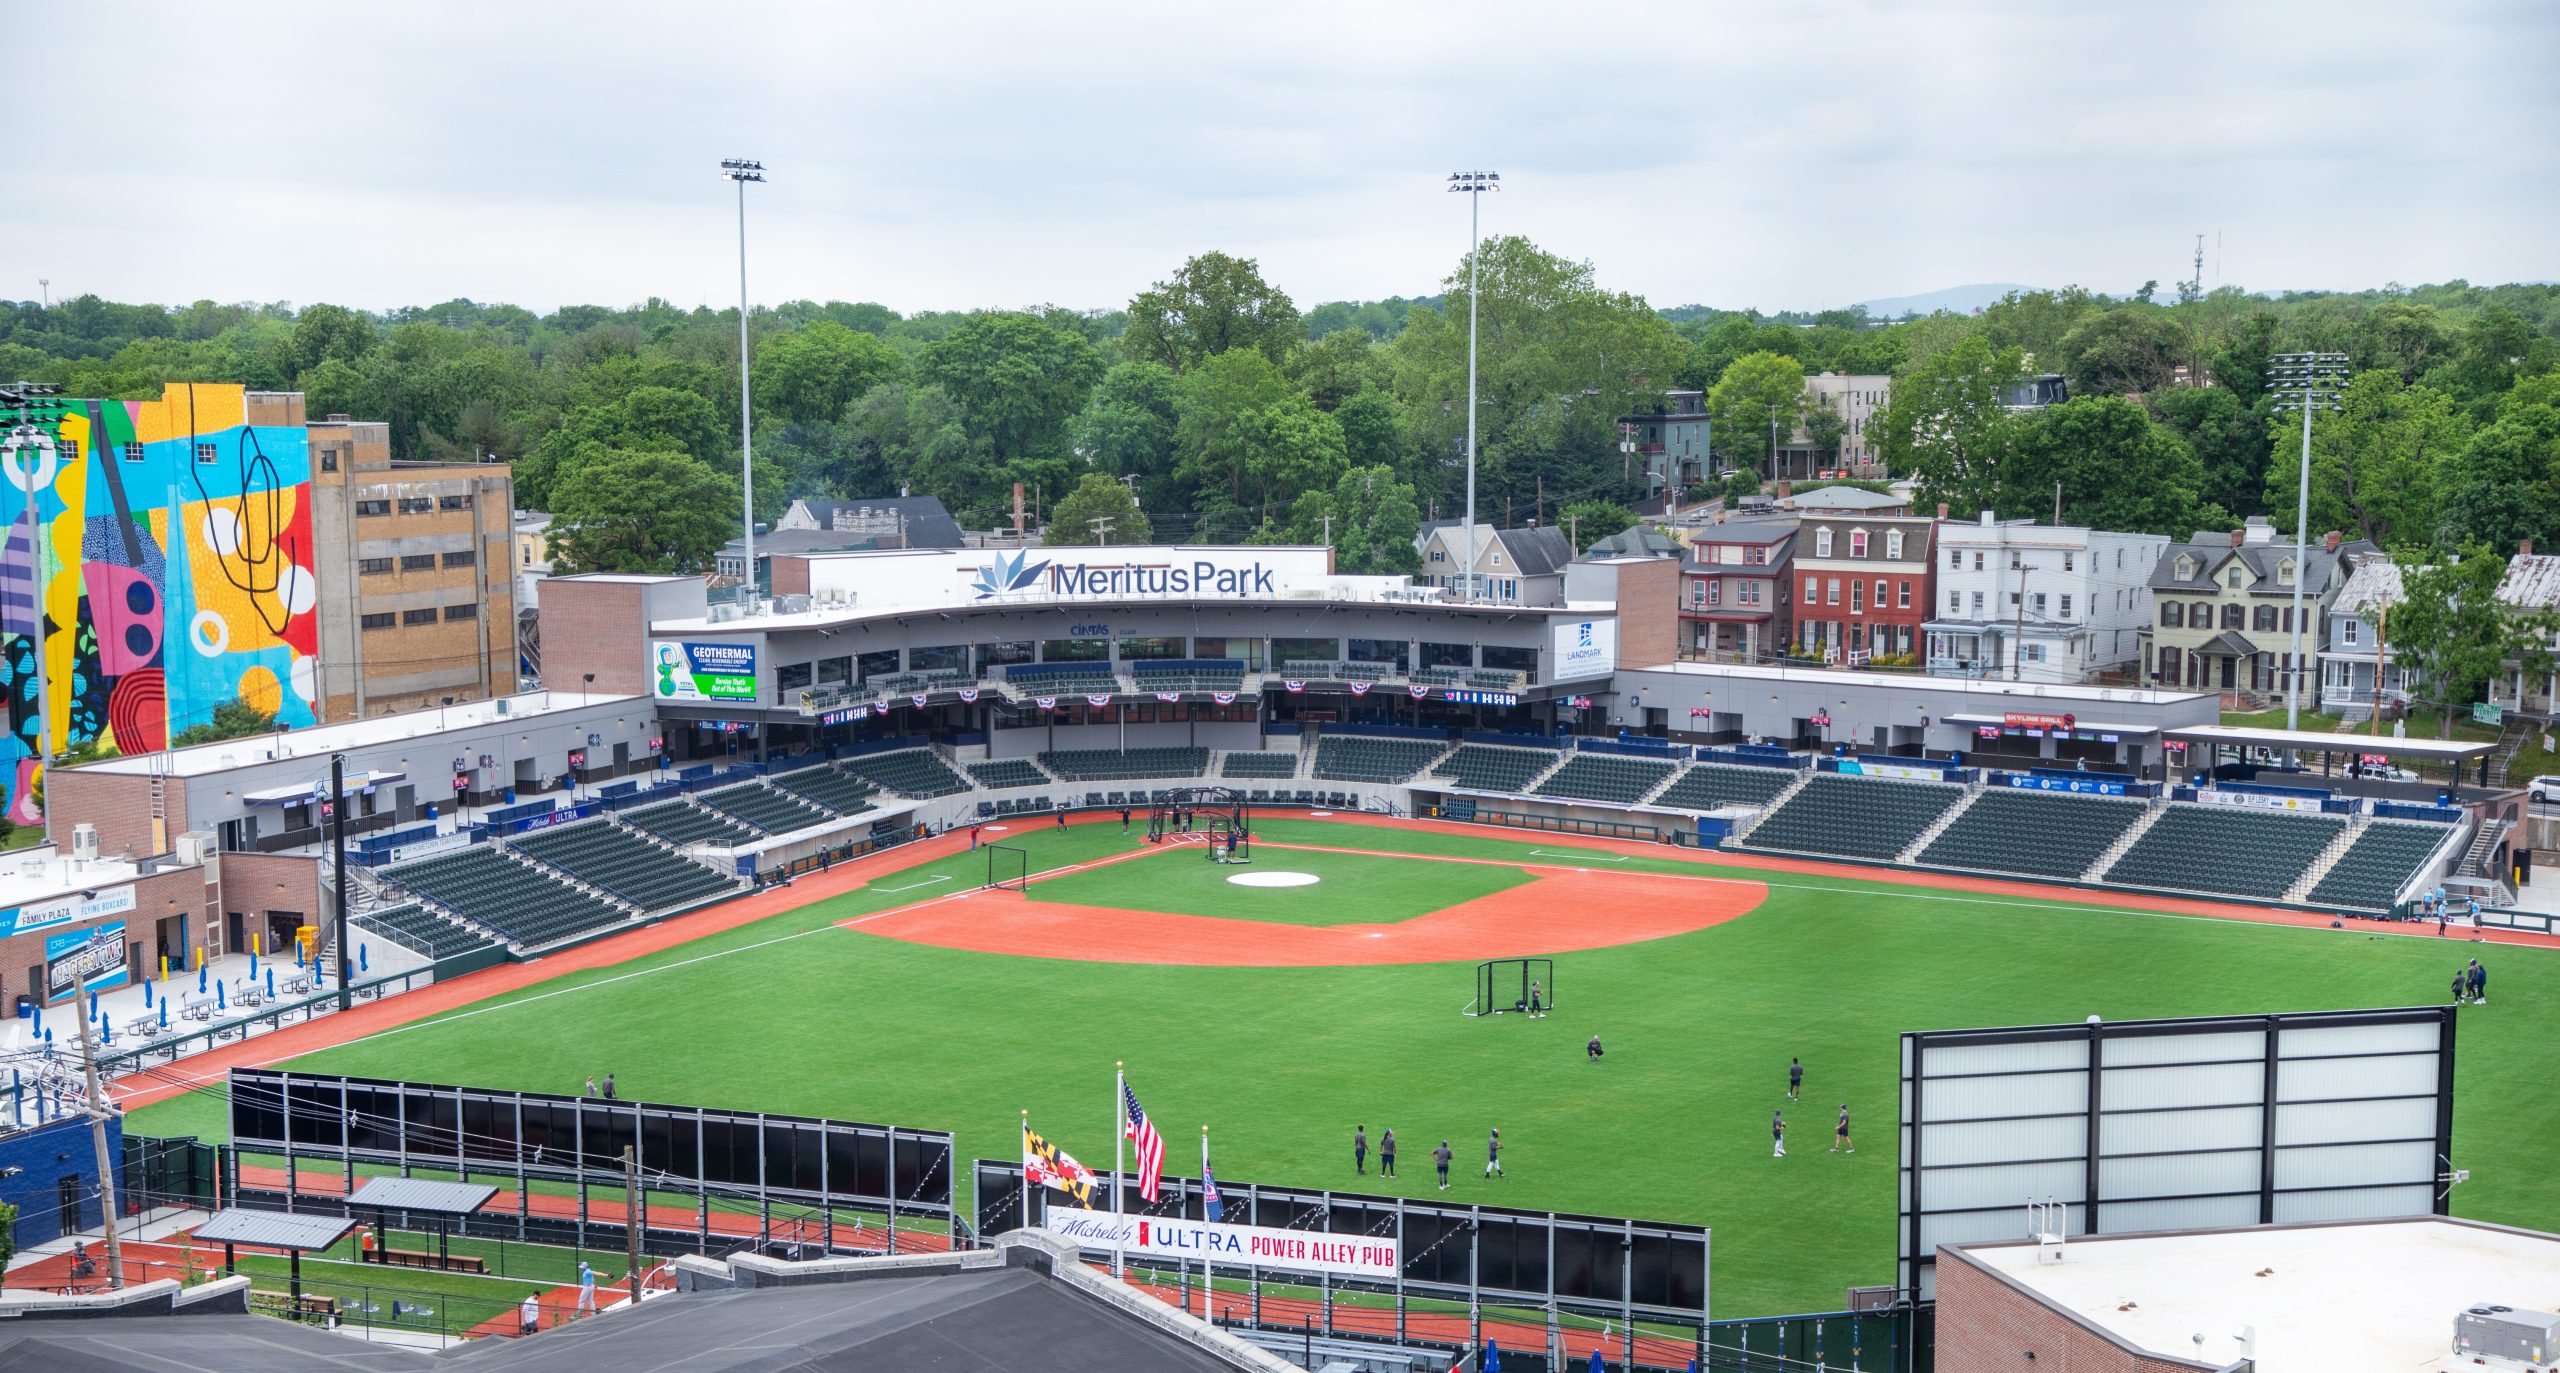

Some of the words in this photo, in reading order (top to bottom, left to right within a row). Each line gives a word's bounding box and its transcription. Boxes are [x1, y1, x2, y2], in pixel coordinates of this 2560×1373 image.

[1055, 562, 1189, 595] Meritus
[1194, 561, 1274, 593] Park
[693, 646, 753, 660] GEOTHERMAL
[1567, 648, 1602, 661] LANDMARK
[2006, 714, 2039, 723] SKYLINE
[555, 809, 578, 823] ULTRA
[81, 903, 101, 915] FLYING
[22, 913, 49, 926] FAMILY
[48, 907, 71, 920] PLAZA
[55, 938, 123, 985] HAGERSTOWN
[1051, 1216, 1134, 1242] Michelob
[1157, 1227, 1242, 1253] ULTRA
[1251, 1236, 1305, 1259] POWER
[1312, 1242, 1356, 1263] ALLEY
[1363, 1246, 1394, 1267] PUB
